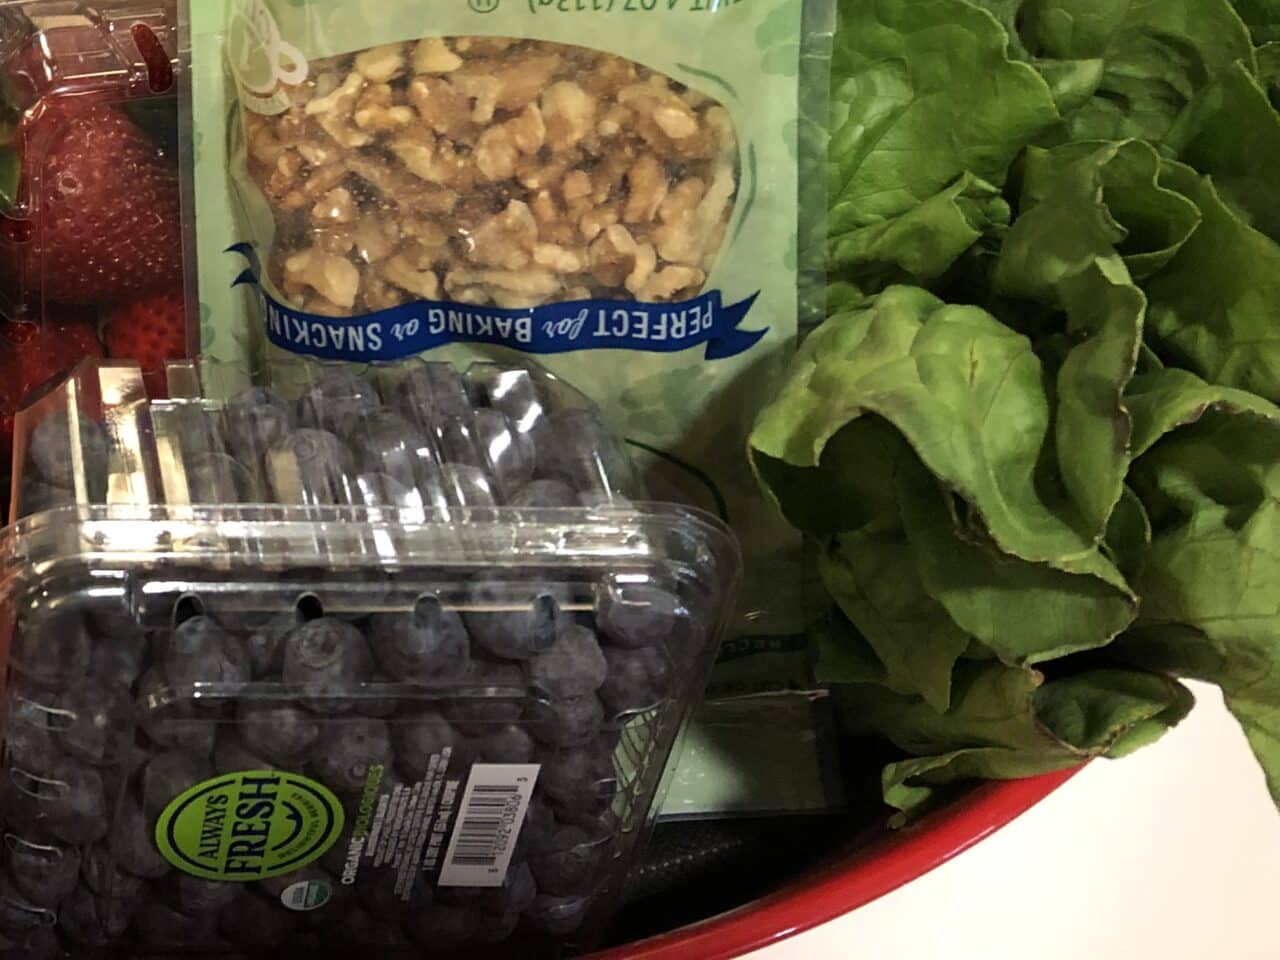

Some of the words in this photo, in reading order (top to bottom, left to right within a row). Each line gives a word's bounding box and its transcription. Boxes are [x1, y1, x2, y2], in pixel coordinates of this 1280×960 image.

[263, 307, 382, 352] SNACKIN
[390, 318, 419, 341] or
[428, 309, 532, 342] BAKING
[542, 308, 589, 341] for
[593, 300, 713, 339] PERFECT
[198, 794, 229, 860] ALWAYS
[224, 776, 281, 874] FRESH
